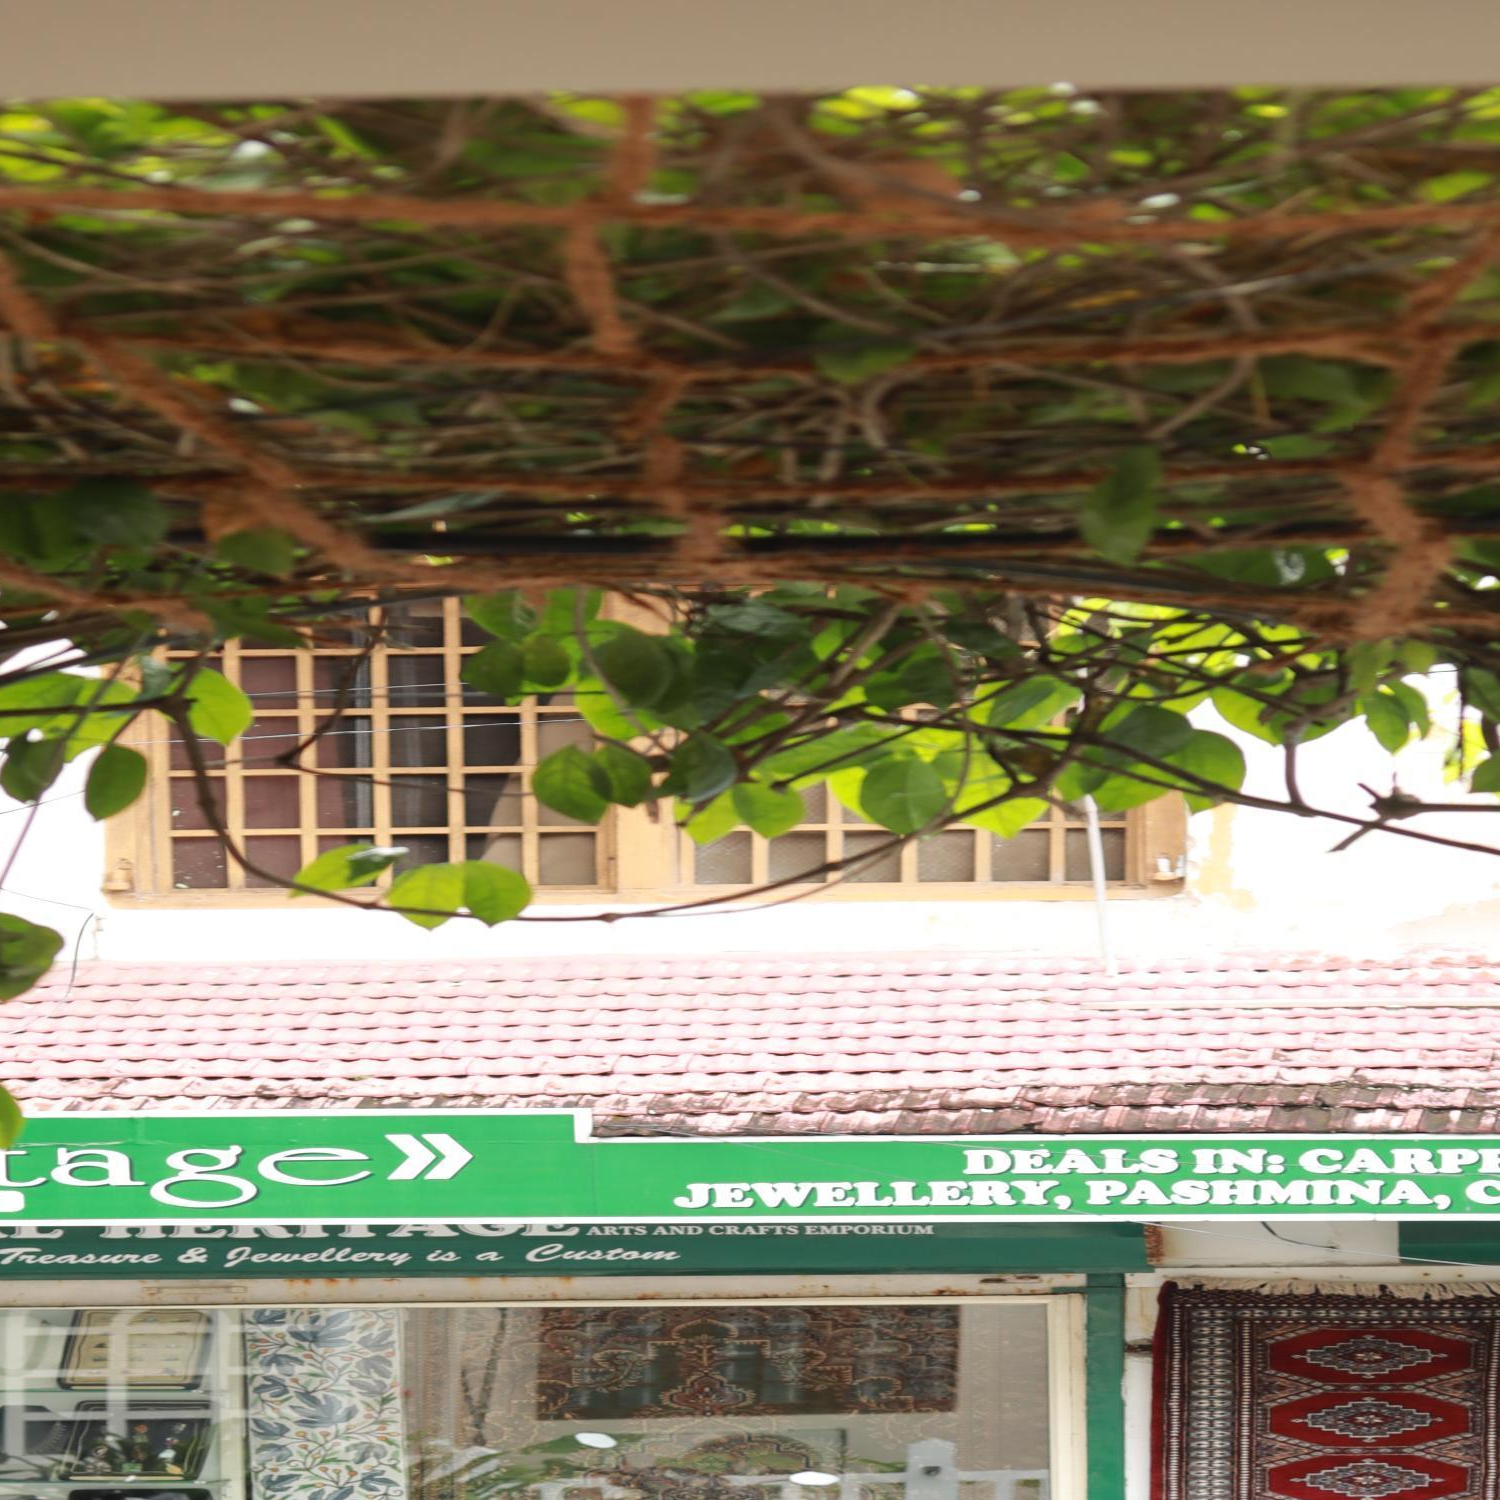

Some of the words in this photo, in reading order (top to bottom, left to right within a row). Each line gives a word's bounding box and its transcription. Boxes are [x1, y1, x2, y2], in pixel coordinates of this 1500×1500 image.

[963, 1148, 1179, 1175] DEALS
[1192, 1148, 1285, 1174] IN:
[673, 1180, 1072, 1210] JEWELLERY,
[1085, 1179, 1451, 1210] PASHMINA,
[586, 1225, 648, 1236] ARTS
[652, 1225, 704, 1236] AND
[708, 1225, 799, 1236] CRAFTS
[803, 1224, 934, 1235] EMPORIUM
[177, 1247, 208, 1264] &
[223, 1246, 413, 1268] Jewellery
[426, 1249, 461, 1262] is
[475, 1251, 505, 1262] a
[525, 1243, 682, 1263] Custom
